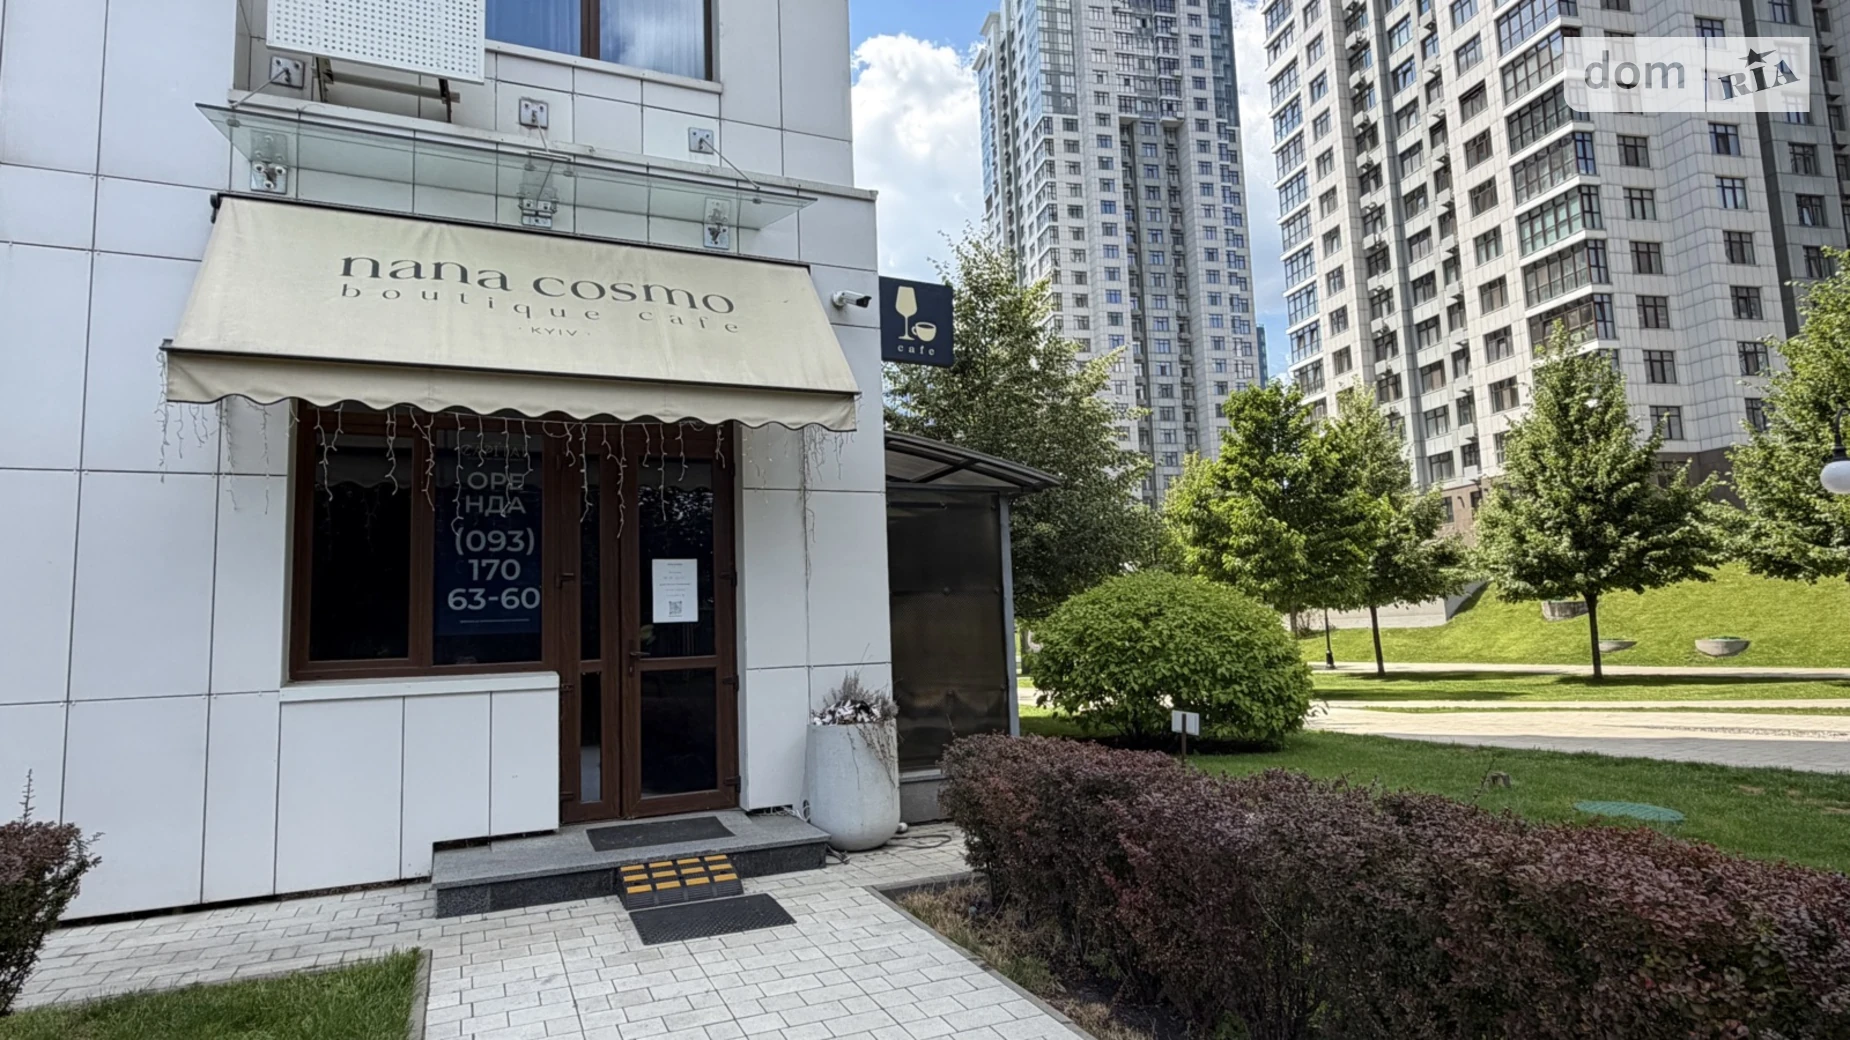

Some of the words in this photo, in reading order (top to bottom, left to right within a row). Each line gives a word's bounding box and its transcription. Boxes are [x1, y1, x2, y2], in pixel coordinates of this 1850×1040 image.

[339, 256, 513, 292] nana
[532, 276, 735, 314] cosmo
[341, 283, 600, 321] boutique
[638, 311, 739, 333] cafe
[531, 326, 578, 337] KYIV
[897, 345, 935, 356] cafe
[467, 471, 524, 490] ОРЕ
[465, 495, 527, 517] НДА
[455, 527, 535, 555] (093)
[468, 559, 521, 581] 170
[447, 587, 540, 610] 63-60
